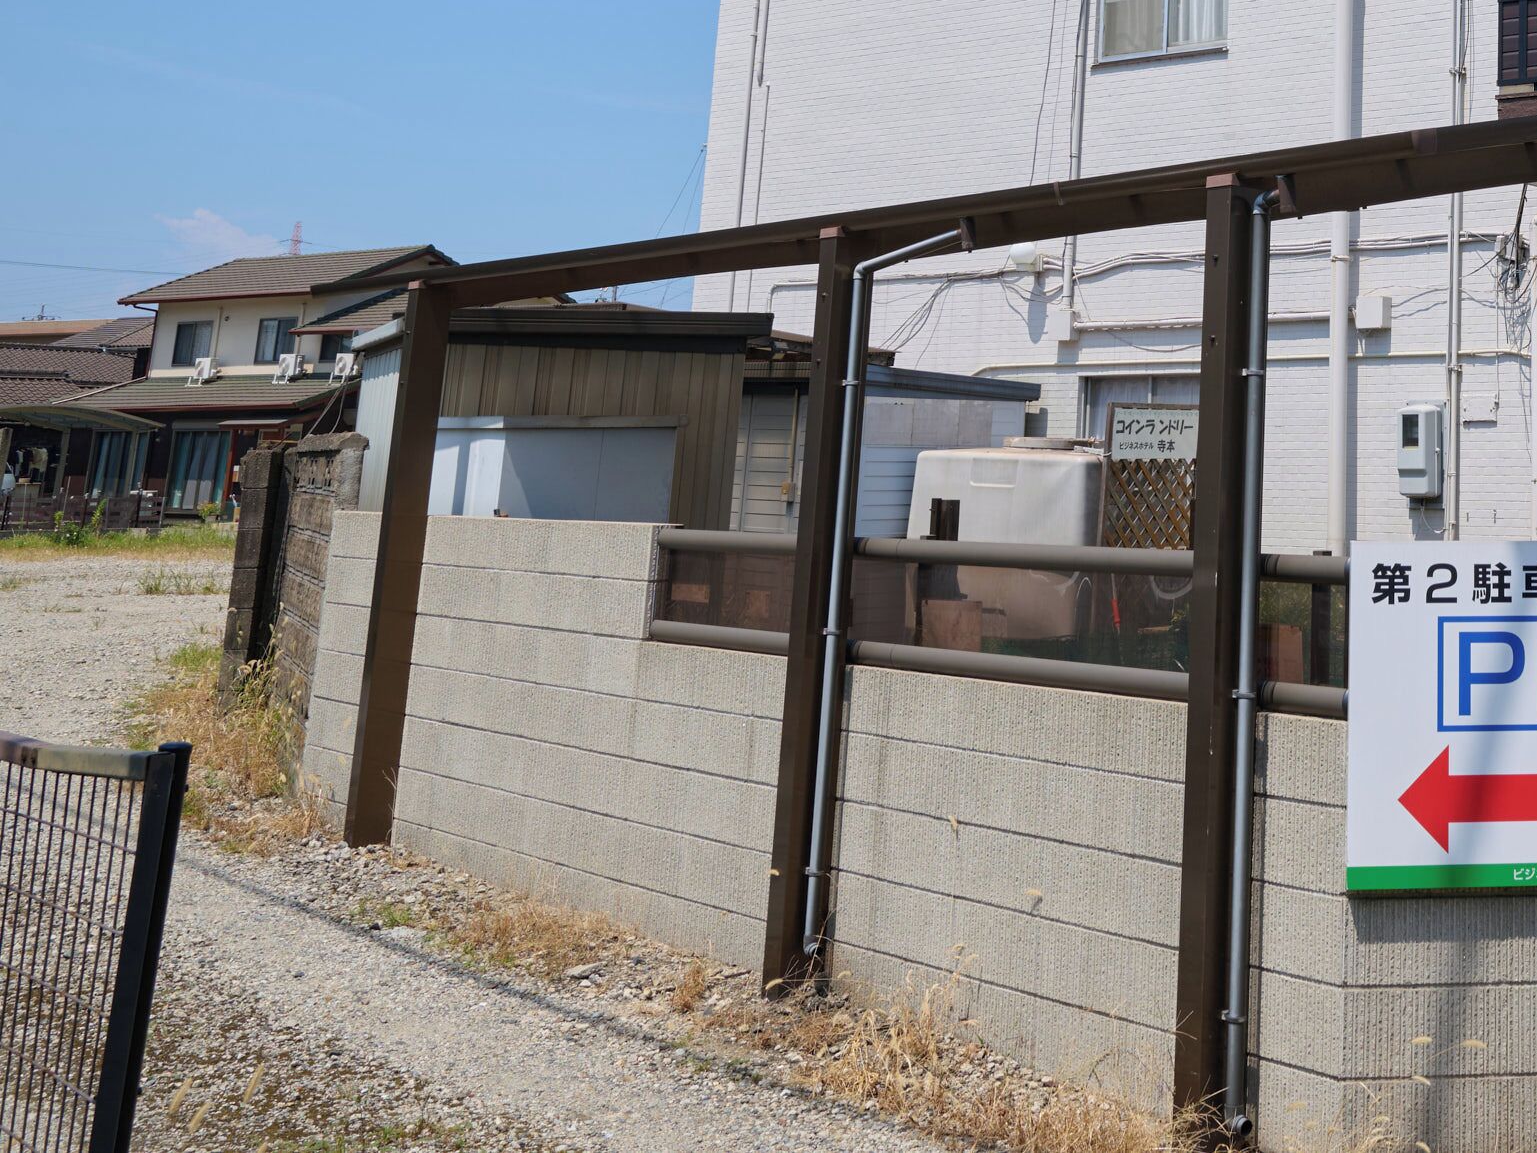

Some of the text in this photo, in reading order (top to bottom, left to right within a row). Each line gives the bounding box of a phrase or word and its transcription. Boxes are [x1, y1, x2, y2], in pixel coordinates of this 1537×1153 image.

[1116, 419, 1193, 435] コインランドリー
[1157, 439, 1175, 453] 寺本
[1458, 631, 1525, 716] P
